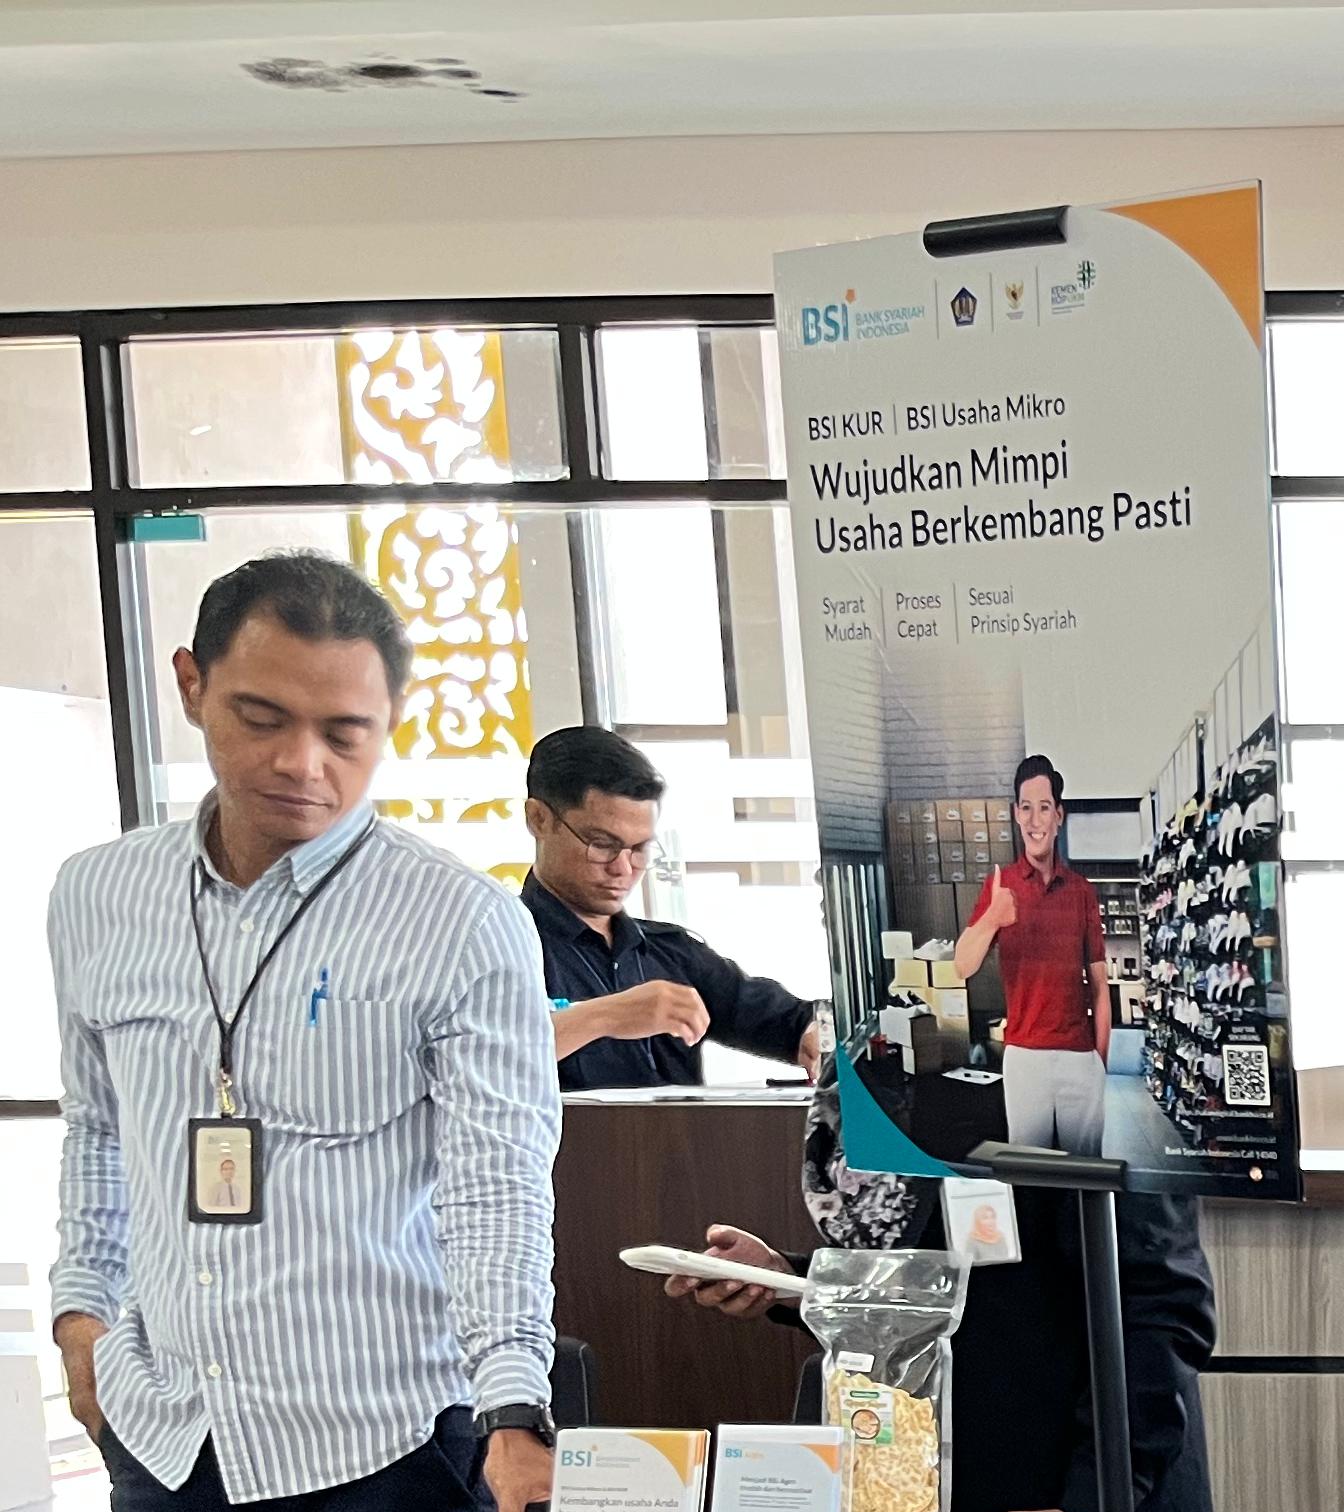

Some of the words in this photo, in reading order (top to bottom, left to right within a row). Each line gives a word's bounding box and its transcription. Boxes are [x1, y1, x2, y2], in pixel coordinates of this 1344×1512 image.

[802, 303, 850, 346] BSI
[855, 309, 882, 325] BANK
[883, 306, 926, 322] SYARIAH
[857, 322, 911, 340] INDONESIA
[907, 404, 937, 431] BSI
[942, 399, 1001, 428] Usaha
[1006, 394, 1066, 421] Mikro
[808, 416, 837, 441] BSI
[842, 411, 884, 438] KUR
[810, 455, 963, 506] Wujudkan
[970, 440, 1069, 493] Mimpi
[815, 513, 902, 554] Usaha
[911, 497, 1104, 547] Berkembang
[1113, 487, 1192, 531] Pasti
[822, 595, 865, 617] Syarat
[895, 591, 941, 611] Proses
[968, 586, 1014, 606] Sesuai
[825, 623, 871, 642] Mudah
[897, 619, 938, 641] Cepat
[970, 614, 1020, 635] Prinsip
[1023, 610, 1077, 633] Syariah
[561, 1450, 592, 1467] BSI
[725, 1448, 742, 1458] BSI
[560, 1497, 623, 1508] Kembangkan
[624, 1499, 652, 1507] usaha
[654, 1499, 679, 1508] Anda
